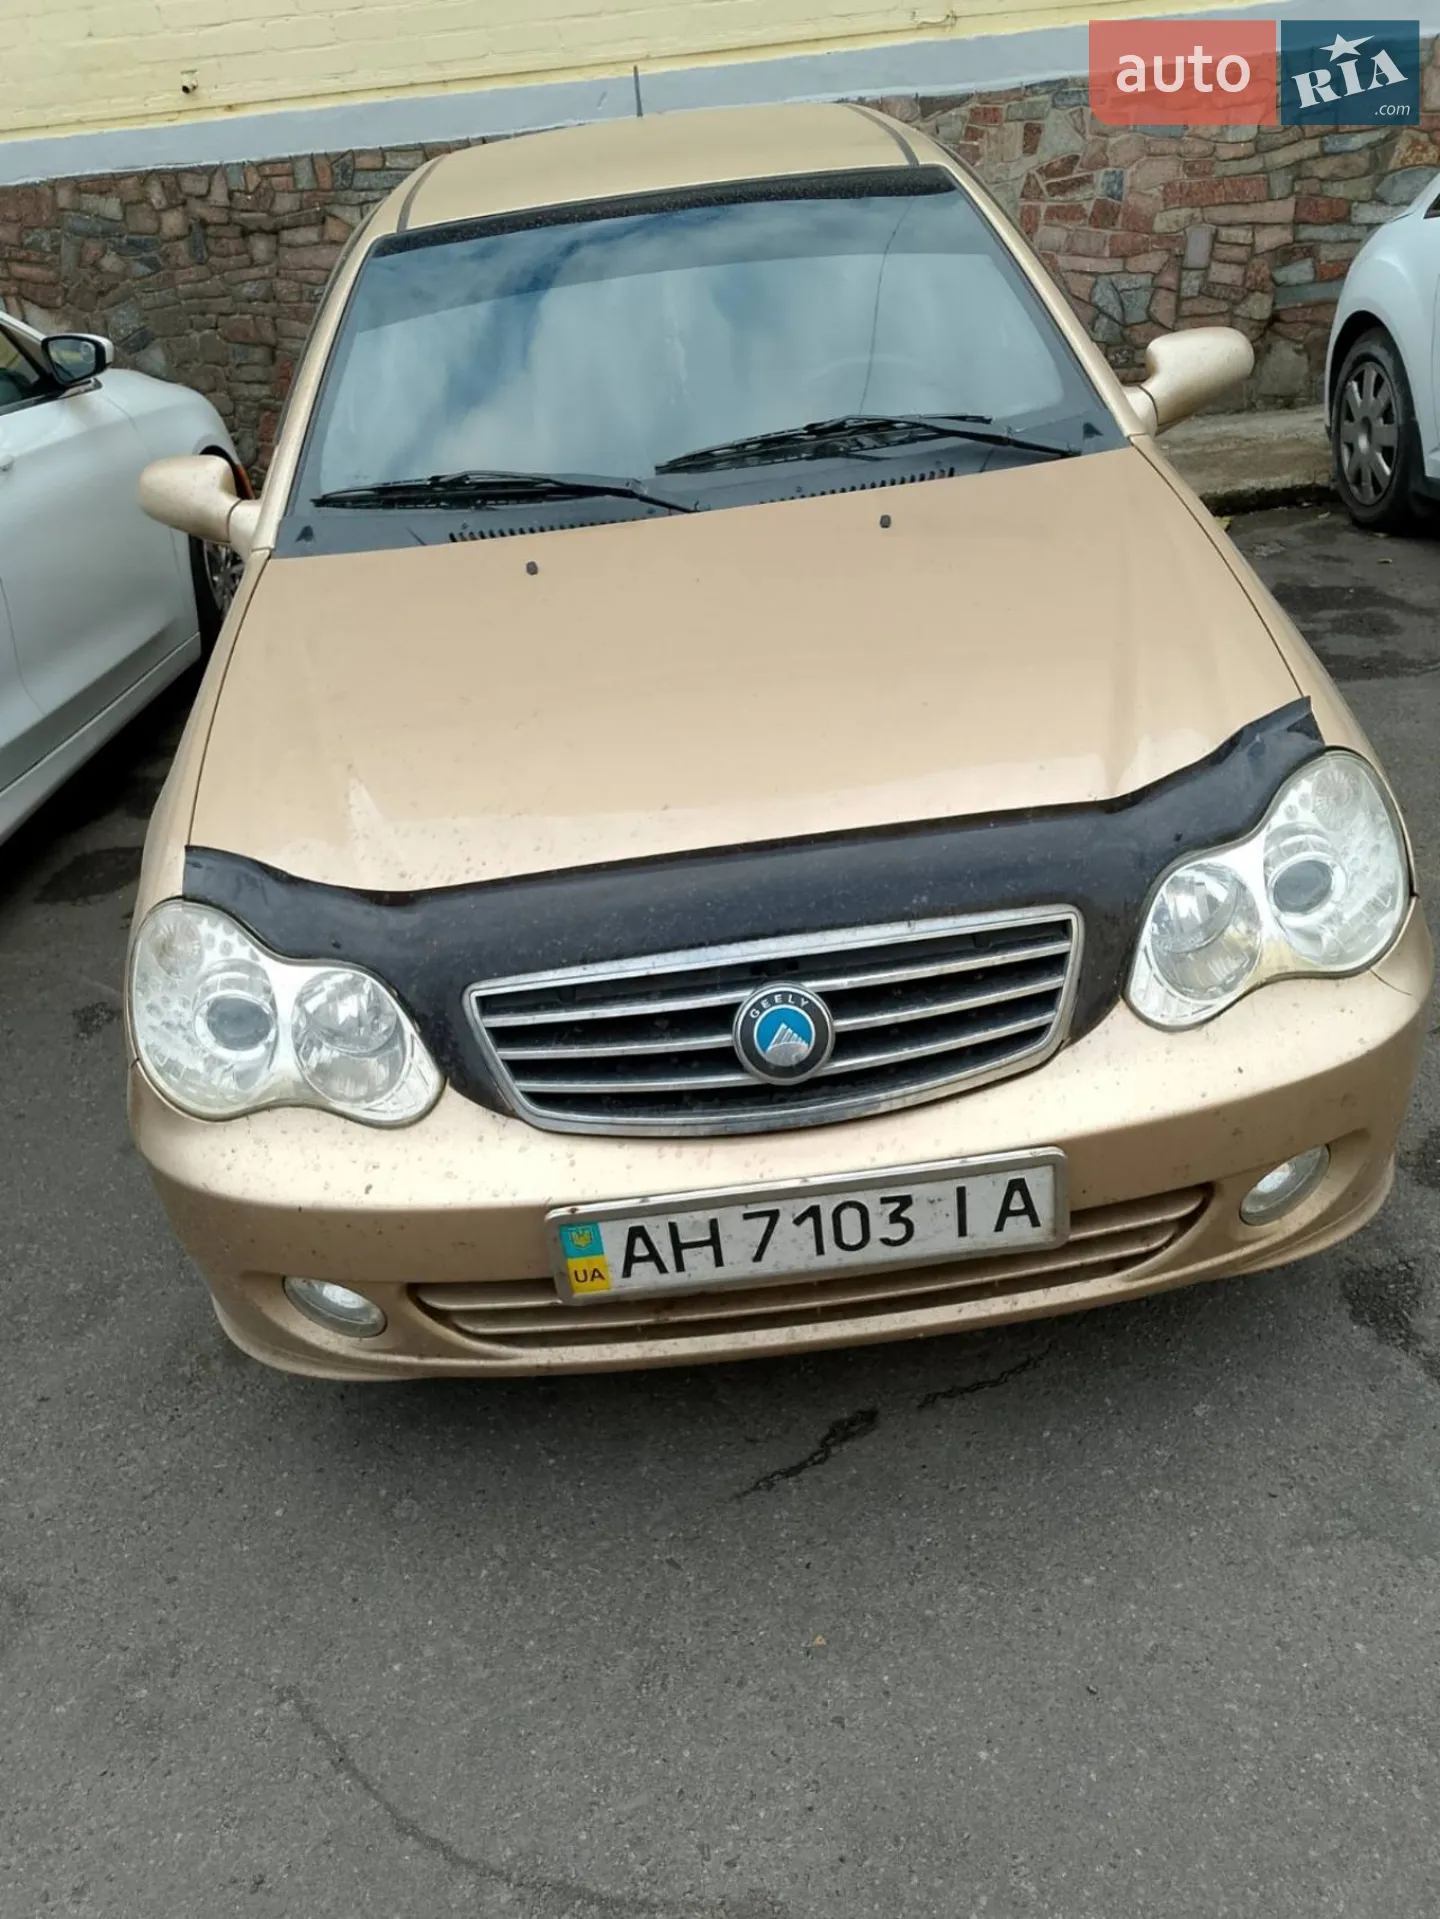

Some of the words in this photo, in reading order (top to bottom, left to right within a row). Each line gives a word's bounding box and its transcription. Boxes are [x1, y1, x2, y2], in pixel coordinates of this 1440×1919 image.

[749, 993, 809, 1019] GEELY
[621, 1218, 724, 1279] AH
[742, 1195, 915, 1263] 7103
[573, 1267, 605, 1285] UA
